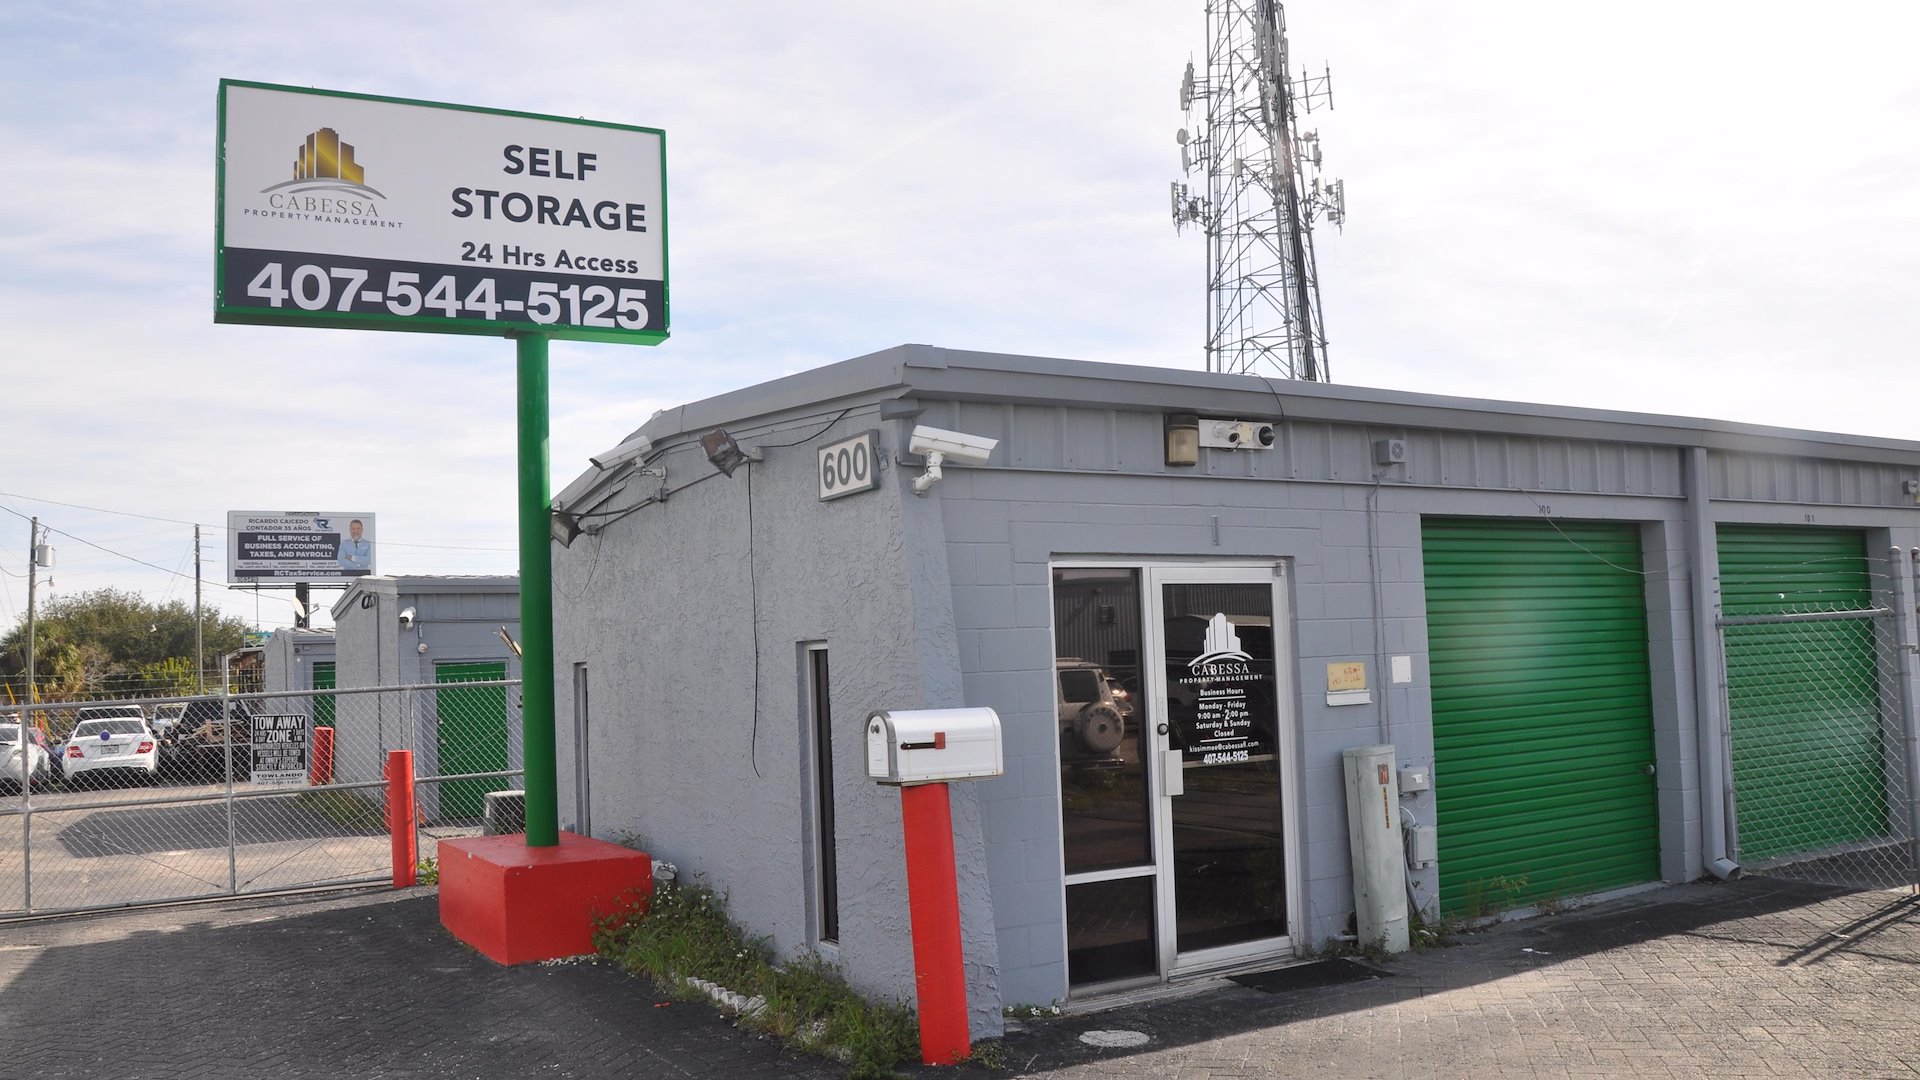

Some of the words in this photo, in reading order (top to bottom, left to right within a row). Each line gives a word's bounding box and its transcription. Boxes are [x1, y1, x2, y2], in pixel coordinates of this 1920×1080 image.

[503, 144, 597, 180] SELF
[269, 193, 379, 218] CABESSA
[451, 187, 646, 232] STORAGE
[244, 208, 310, 222] PROPERTY
[314, 215, 402, 228] MANAGEMENT
[461, 241, 493, 263] 24
[503, 246, 546, 268] Hrs
[554, 250, 638, 274] Access
[247, 262, 648, 330] 407-544-5125
[823, 442, 867, 489] 600
[1538, 506, 1550, 514] 100
[1192, 663, 1249, 676] CABESSA
[1199, 703, 1223, 711] Monday
[1227, 702, 1246, 710] Friday
[254, 717, 274, 729] TOW
[276, 716, 304, 729] AWAY
[1225, 710, 1238, 720] 2:00
[1196, 721, 1222, 730] Saturday
[1230, 719, 1250, 728] Sunday
[266, 730, 292, 742] ZONE
[1203, 750, 1249, 765] 407-544-5125
